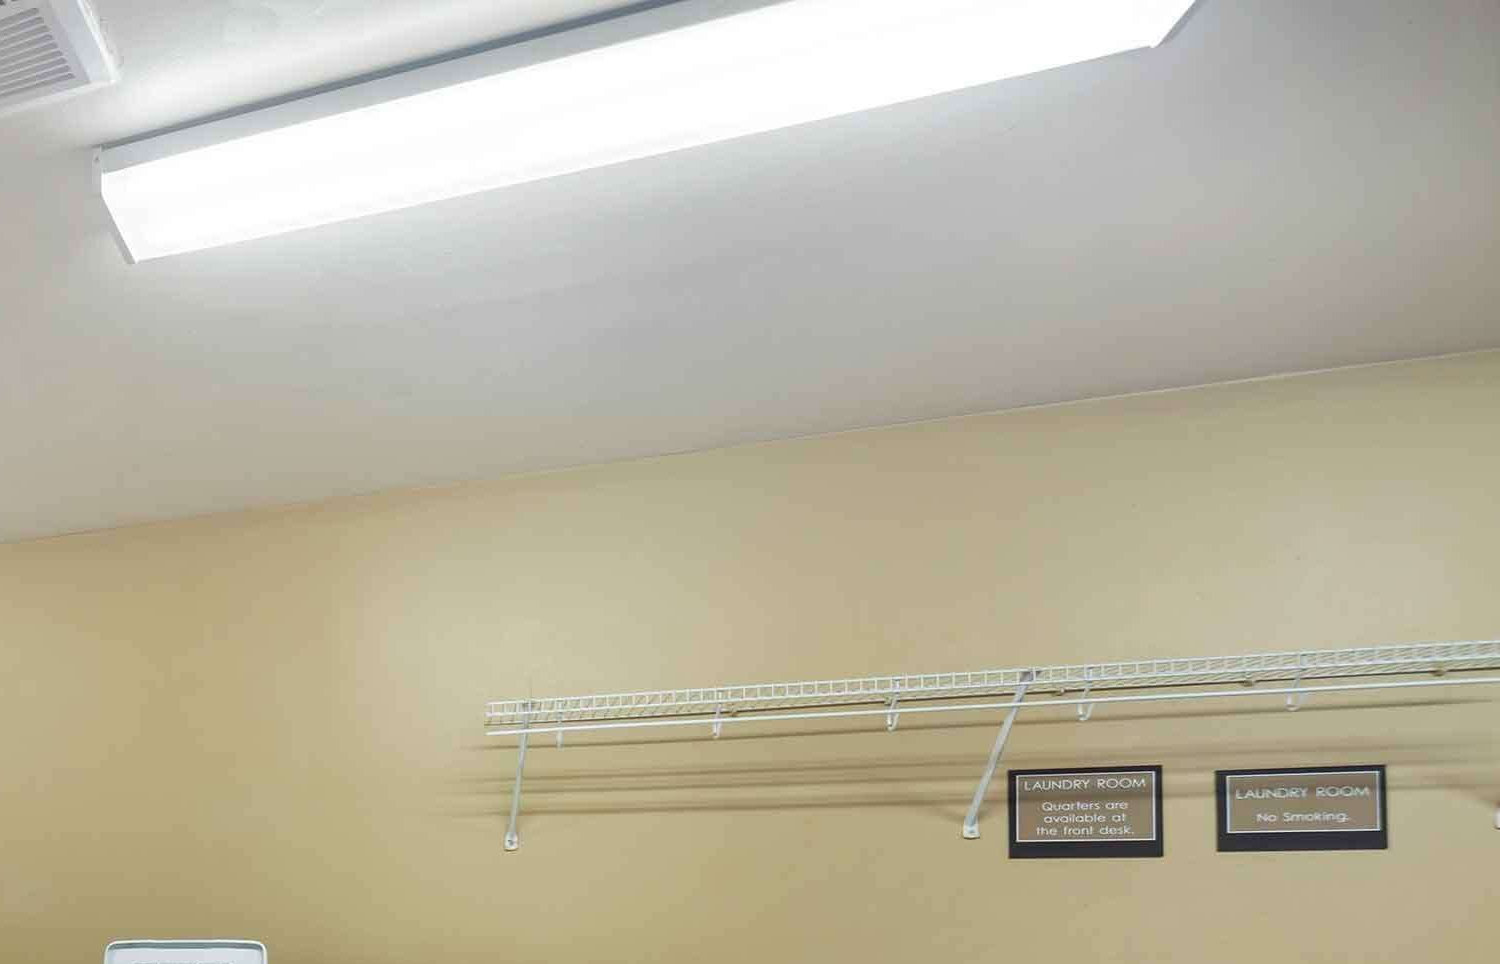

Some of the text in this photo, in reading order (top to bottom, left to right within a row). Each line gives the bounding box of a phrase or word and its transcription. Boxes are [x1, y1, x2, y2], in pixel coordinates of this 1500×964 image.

[1024, 777, 1146, 791] LAUNDRY ROOM
[1235, 786, 1370, 800] LAUNDRY ROOM
[1042, 801, 1129, 812] Quarters are
[1043, 813, 1126, 824] available at
[1256, 813, 1277, 822] No
[1036, 826, 1058, 836] the
[1063, 825, 1093, 836] front
